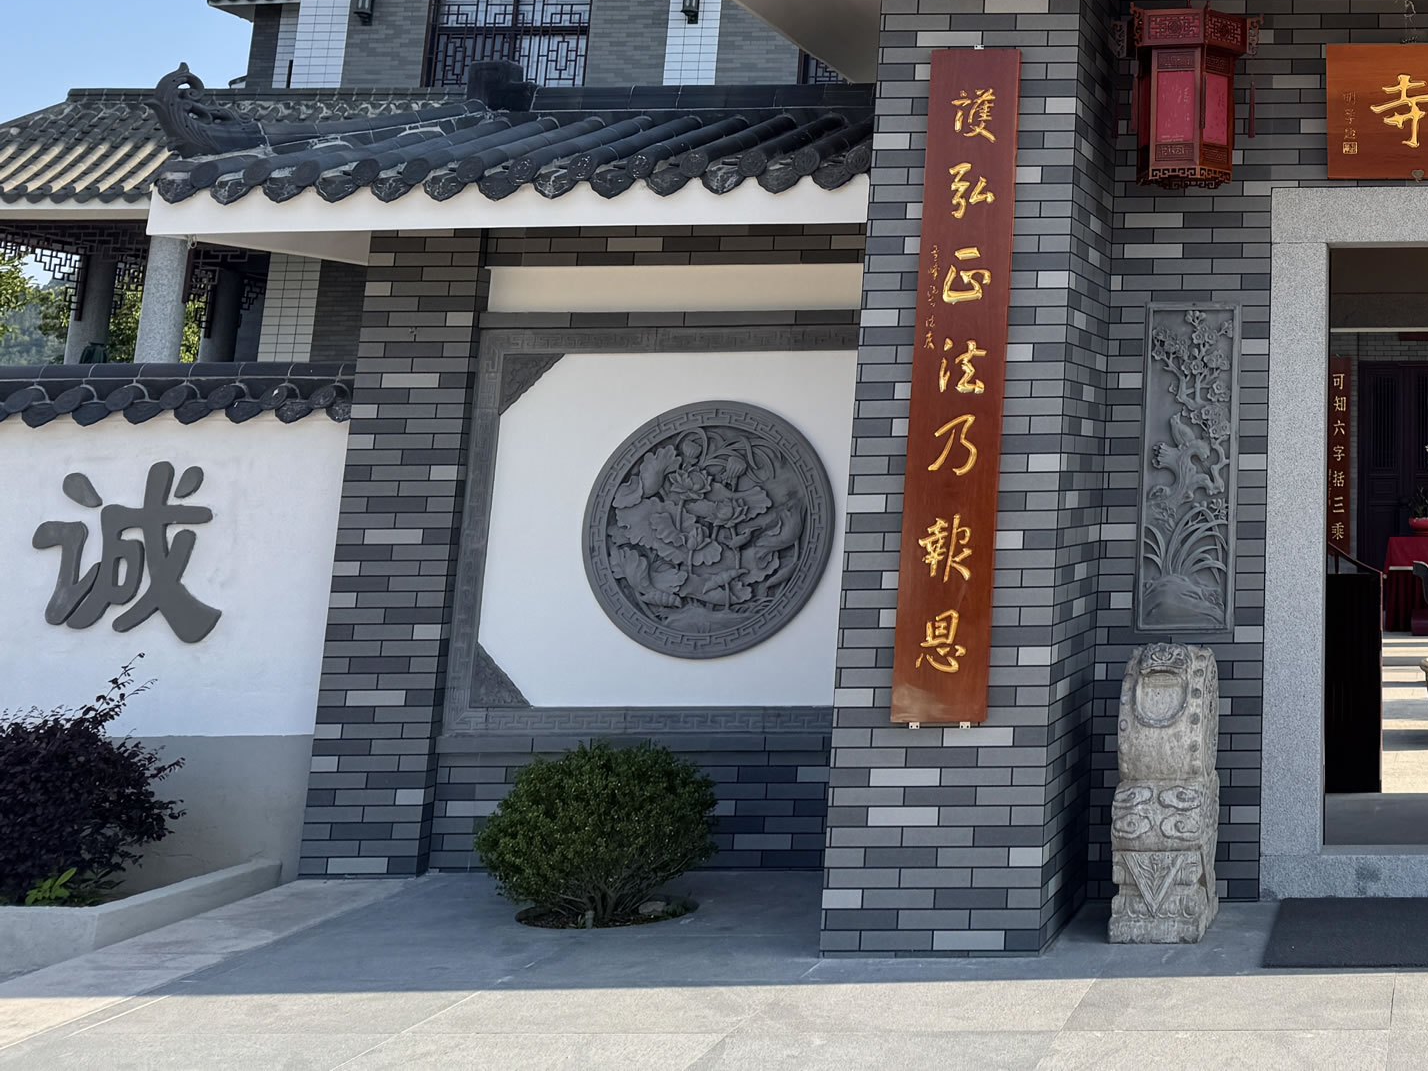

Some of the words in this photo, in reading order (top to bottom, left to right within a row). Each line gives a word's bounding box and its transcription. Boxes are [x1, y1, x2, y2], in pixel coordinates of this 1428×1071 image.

[32, 461, 222, 643] 诚
[914, 87, 997, 674] 護弘正法乃報恩
